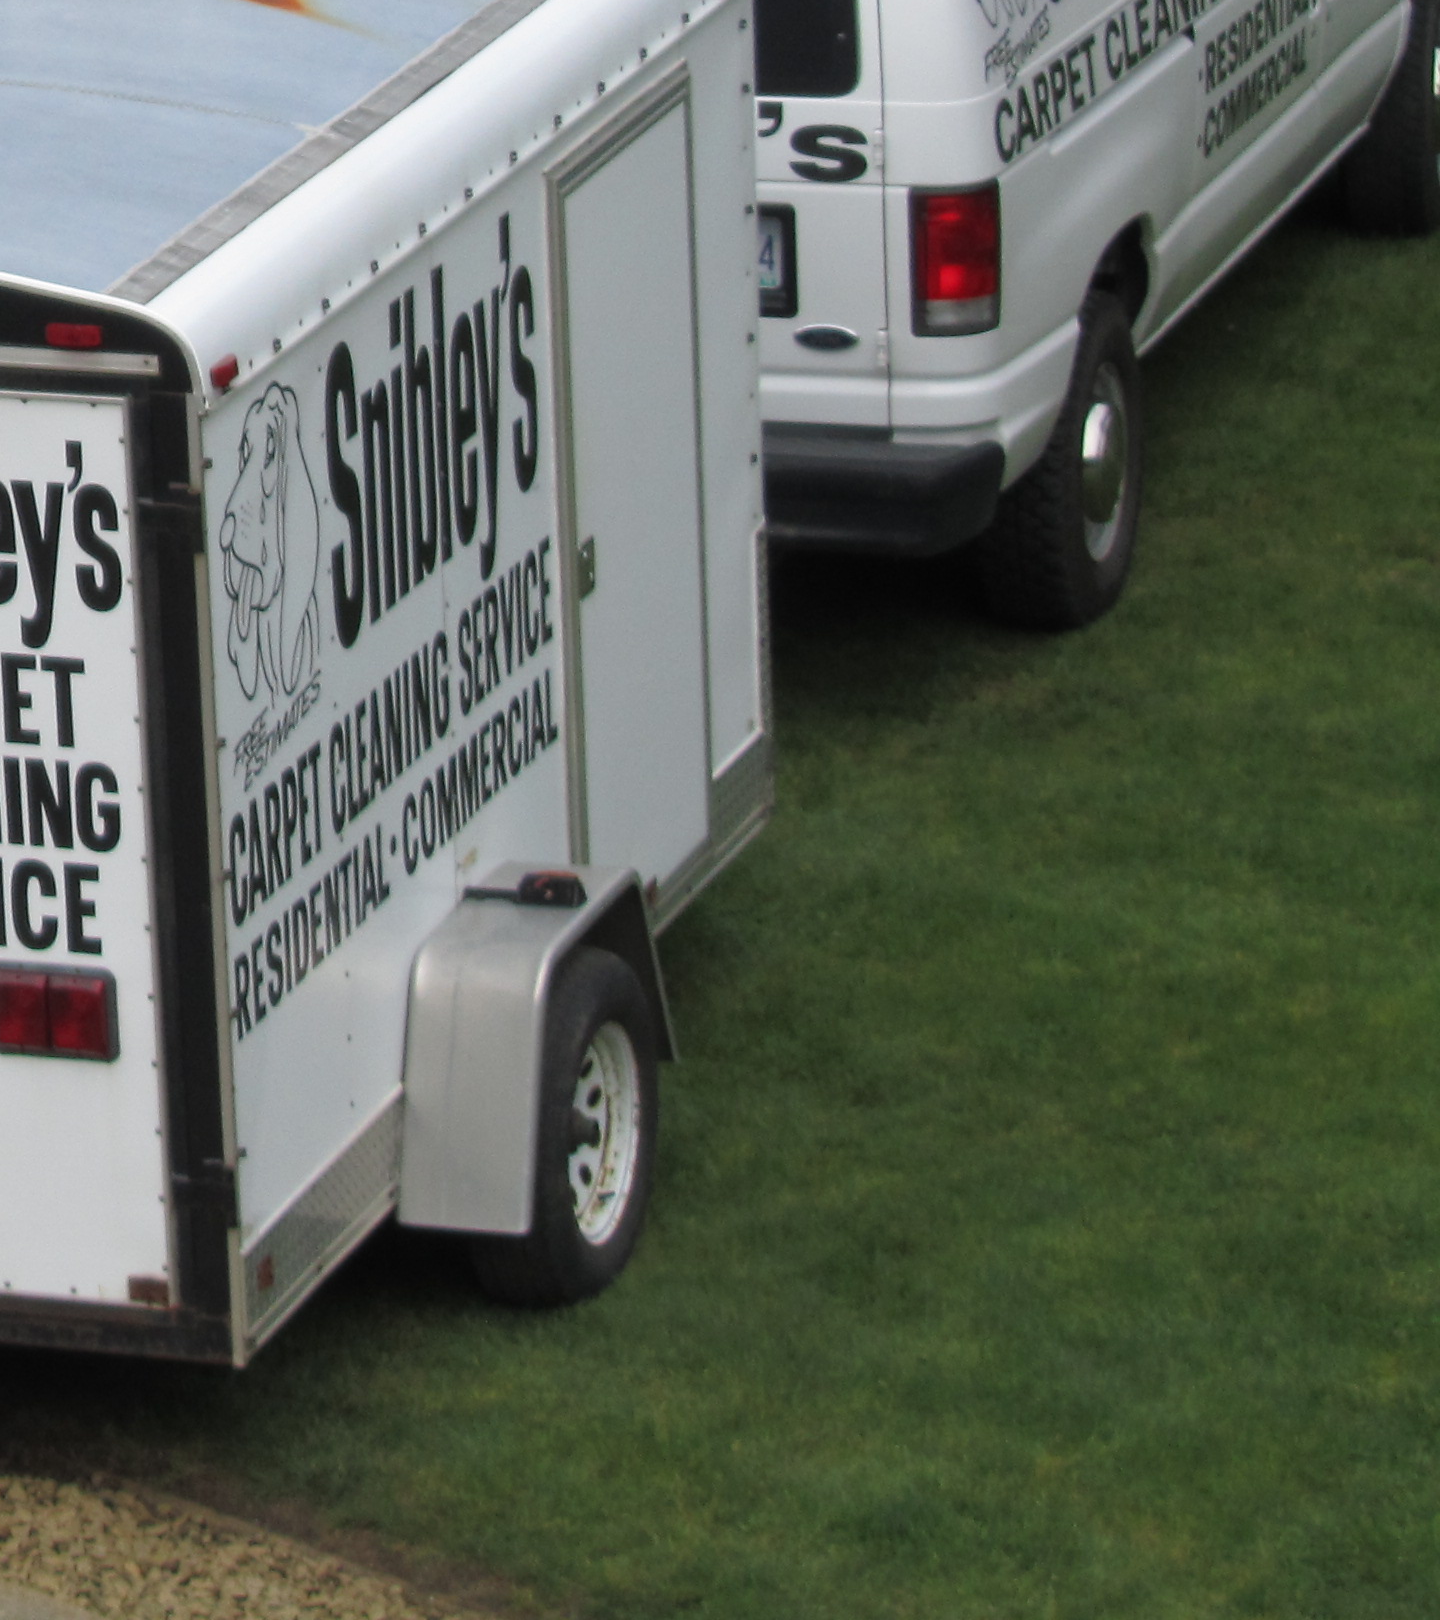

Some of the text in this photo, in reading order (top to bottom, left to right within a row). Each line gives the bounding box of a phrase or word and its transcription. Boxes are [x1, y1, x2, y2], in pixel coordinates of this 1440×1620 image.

[994, 34, 1096, 164] CARPET
[326, 211, 537, 649] Snibley's
[228, 536, 554, 927] CARPET CLEANING SERVICE
[233, 668, 558, 1042] RESIDENTIAL COMMERCIAL
[234, 706, 268, 777] FREE
[245, 669, 320, 792] ESTIMATES
